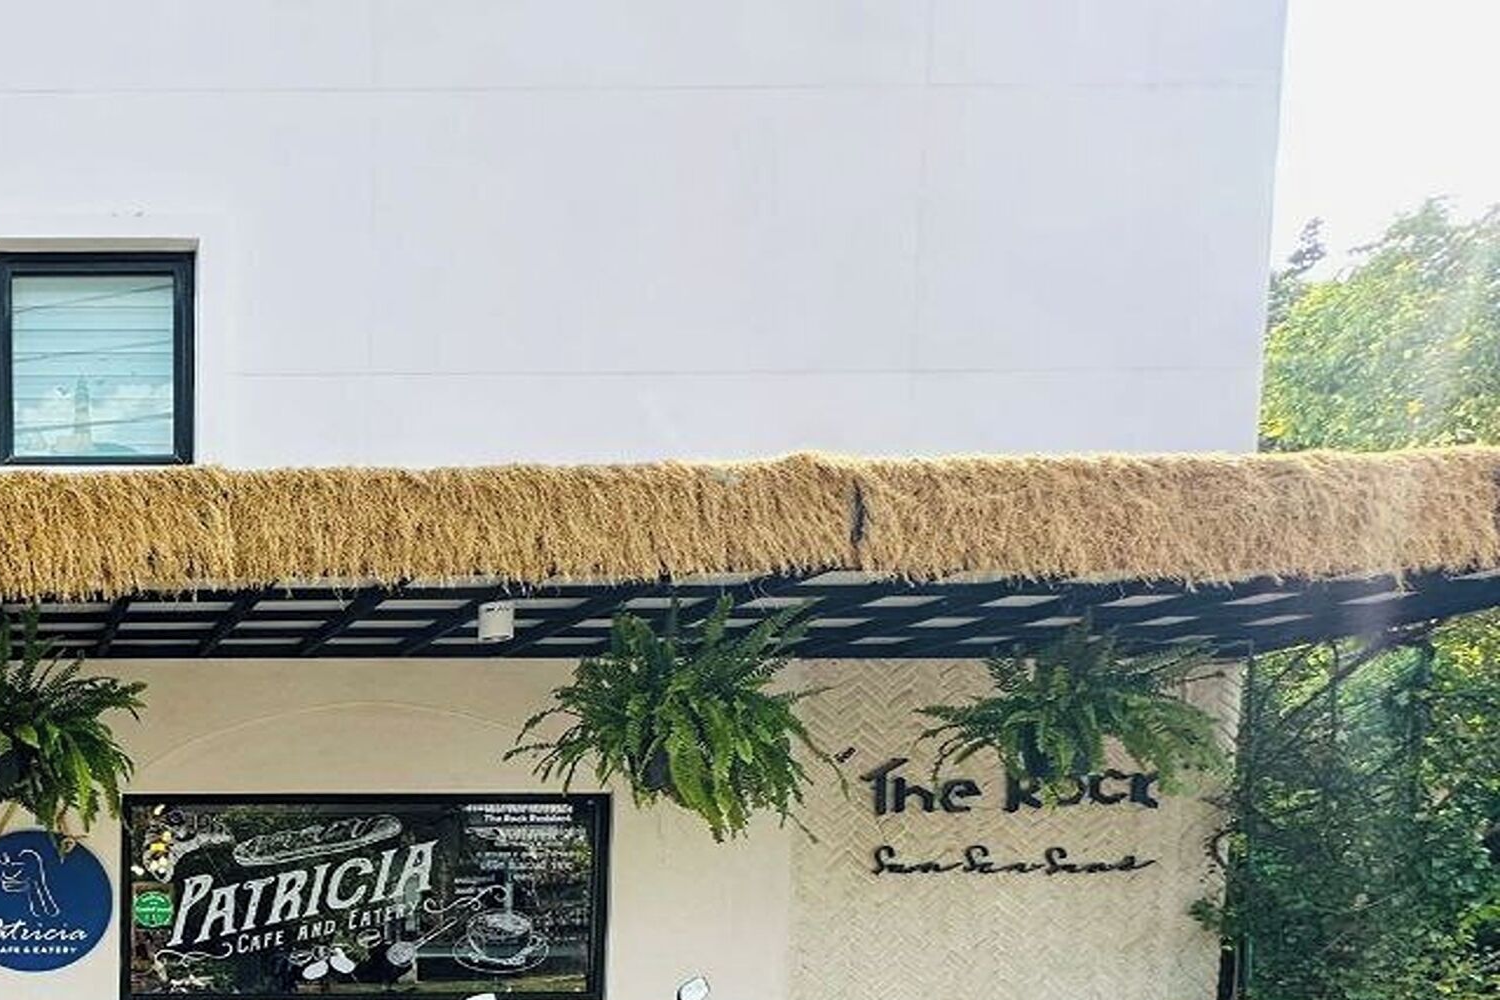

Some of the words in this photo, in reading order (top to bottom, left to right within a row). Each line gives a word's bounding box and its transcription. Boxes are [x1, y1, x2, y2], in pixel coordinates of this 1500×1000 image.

[859, 756, 982, 814] The
[166, 840, 439, 948] PATRICIA
[33, 946, 78, 954] EATERY
[237, 929, 285, 953] CAFE
[298, 919, 337, 942] AND
[349, 900, 420, 930] EATERY
